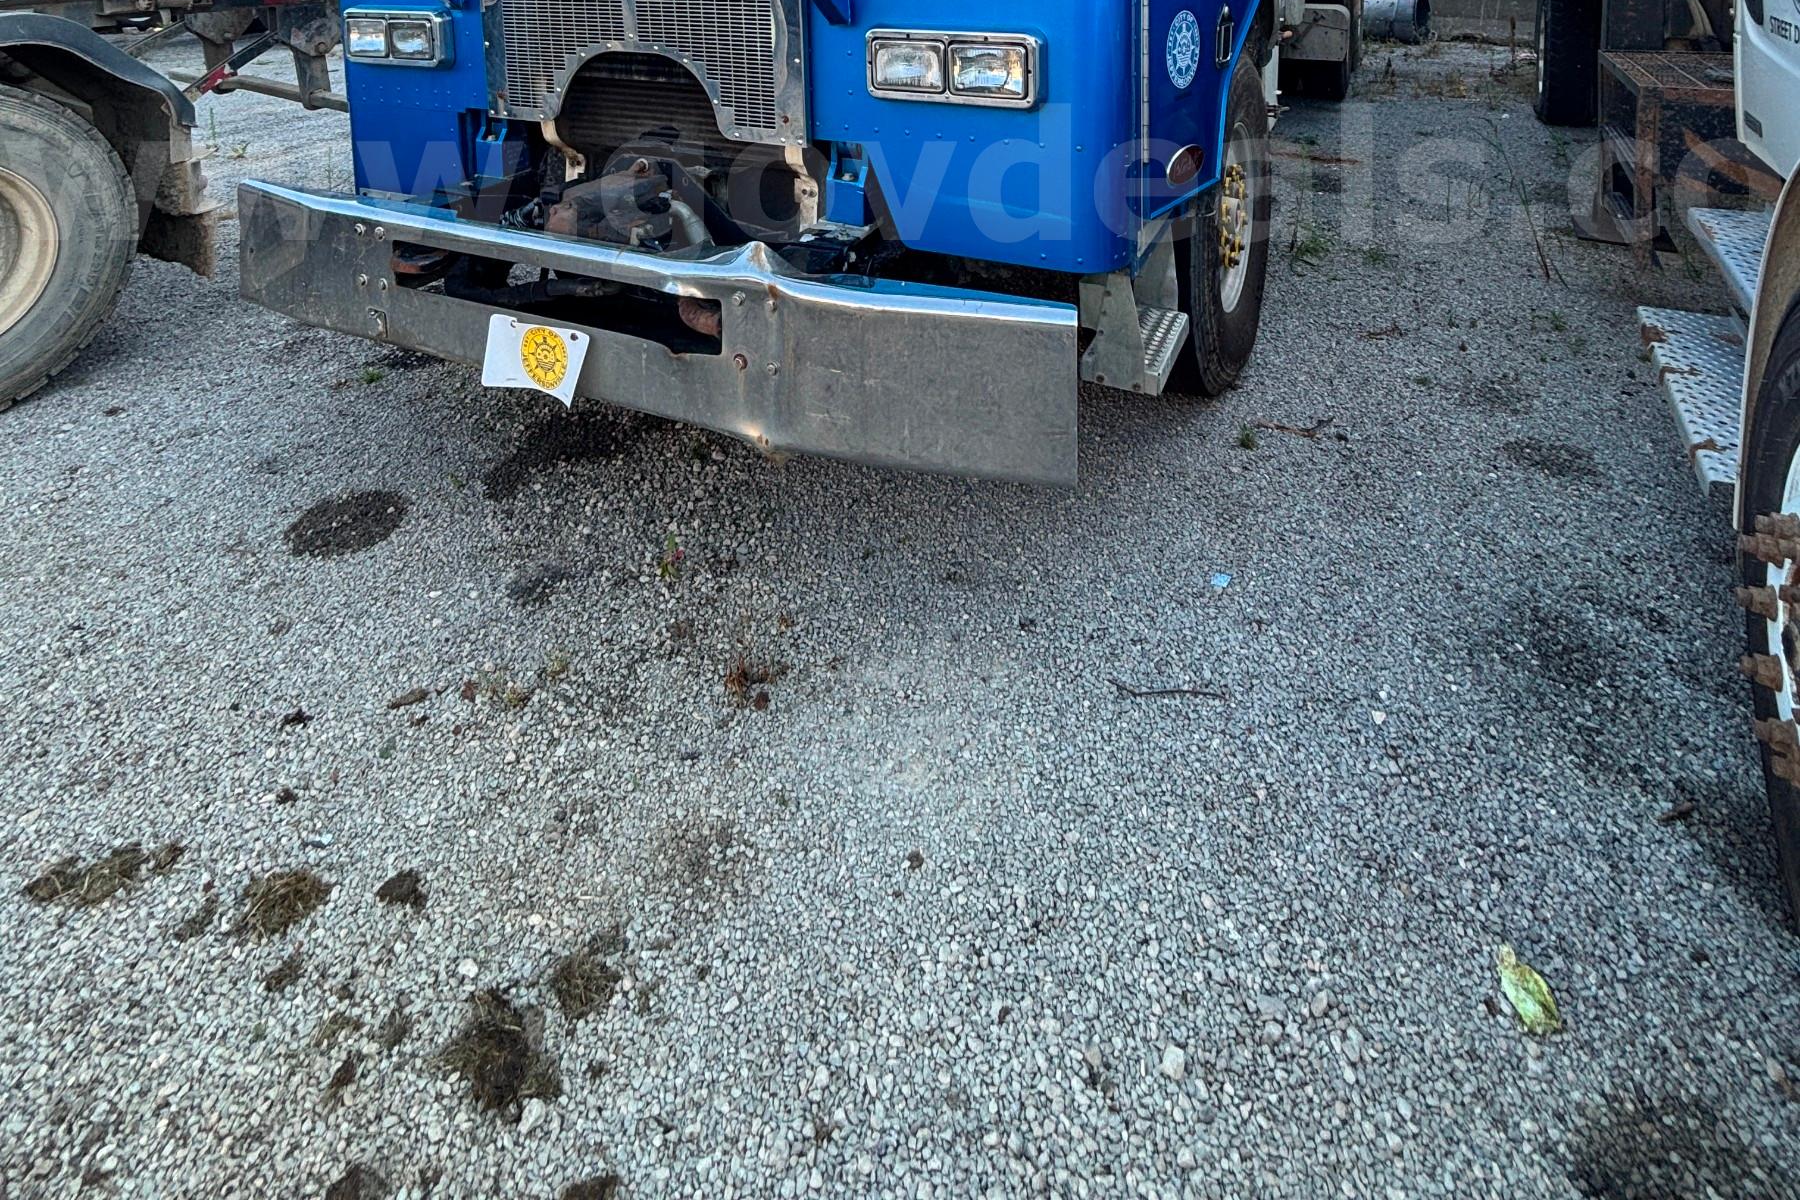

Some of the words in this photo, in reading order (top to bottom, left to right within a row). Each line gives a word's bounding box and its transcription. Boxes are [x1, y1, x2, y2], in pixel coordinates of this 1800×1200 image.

[1768, 14, 1793, 43] STREET
[531, 328, 546, 337] CITY
[549, 330, 559, 339] OF
